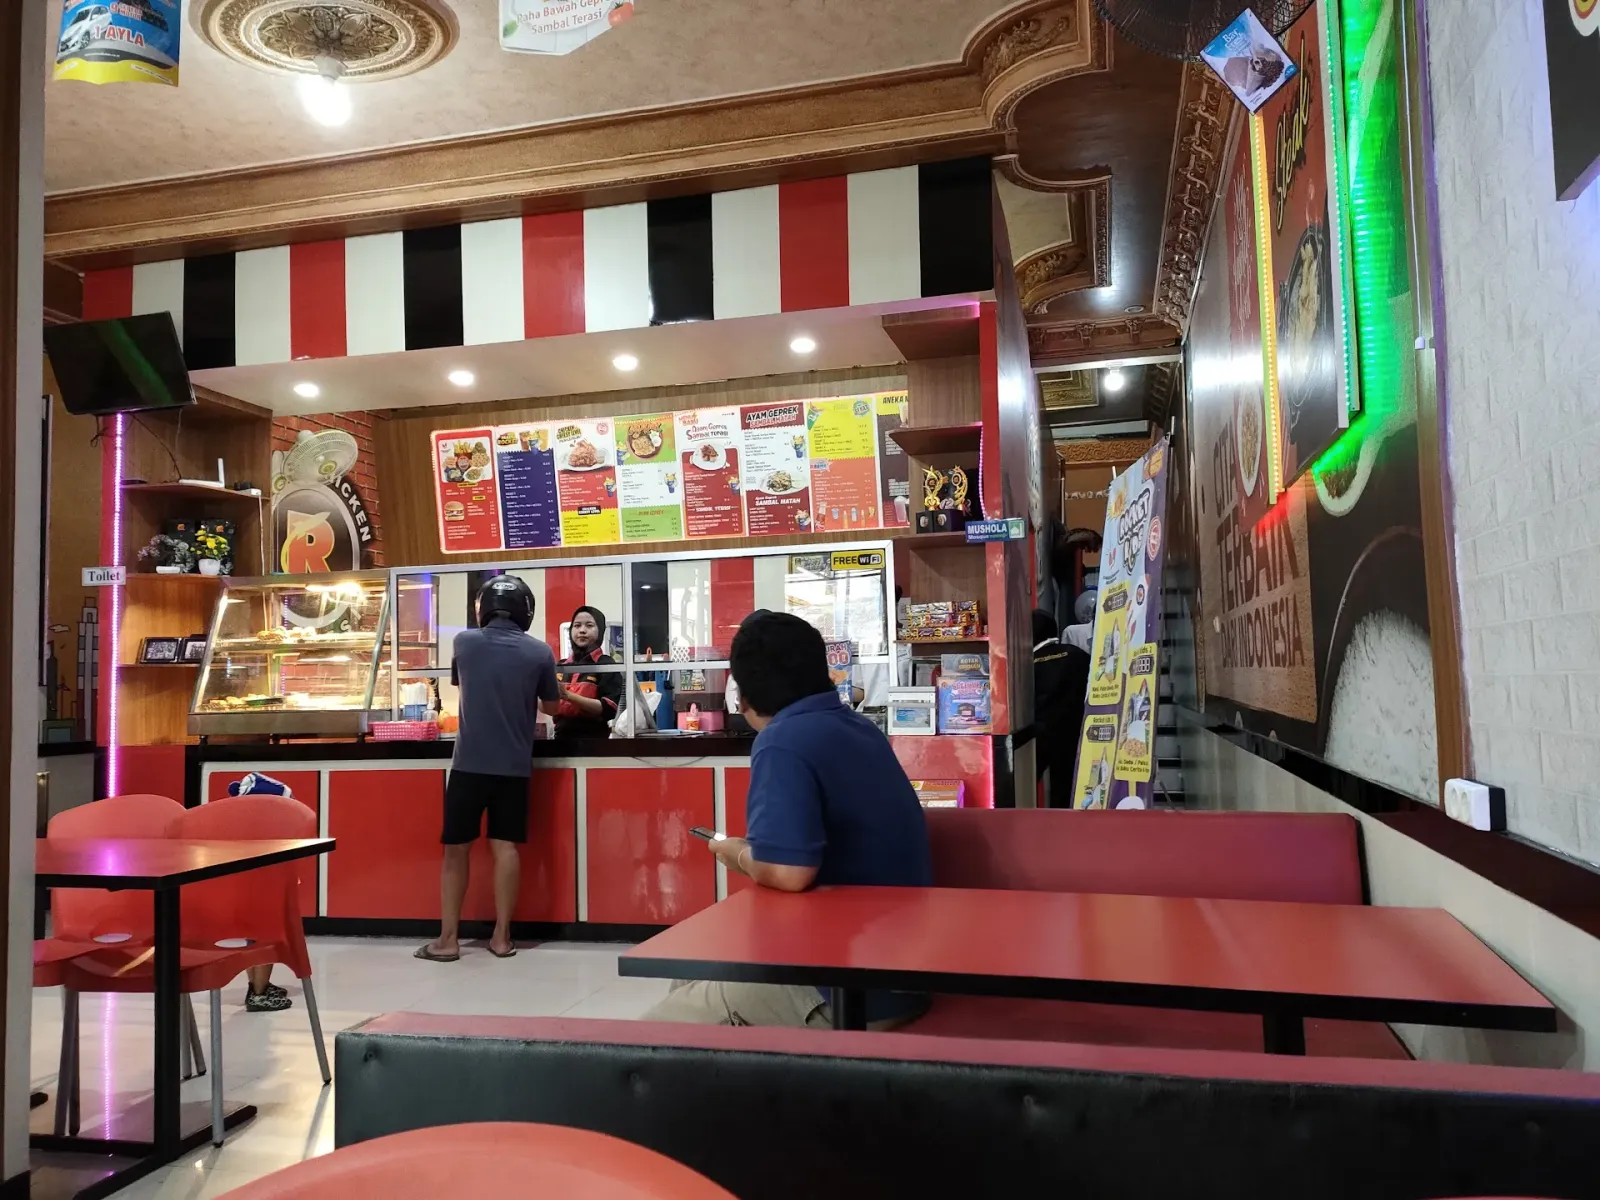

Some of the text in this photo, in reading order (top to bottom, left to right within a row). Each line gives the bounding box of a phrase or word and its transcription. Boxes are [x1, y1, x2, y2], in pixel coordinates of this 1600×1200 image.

[543, 1, 577, 17] Bawah
[532, 8, 602, 34] Sambal Terasi
[105, 24, 145, 48] AYLA
[883, 396, 904, 404] ANEKA
[746, 405, 798, 423] AYAM GEPREK
[755, 497, 801, 507] SAMBAL MATAH
[1119, 488, 1150, 542] ROCKET
[967, 523, 1007, 534] MUSHOLA
[833, 556, 857, 565] FREE
[88, 570, 120, 582] Toilet
[1238, 593, 1304, 668] INDONESIA
[826, 643, 847, 653] URAH
